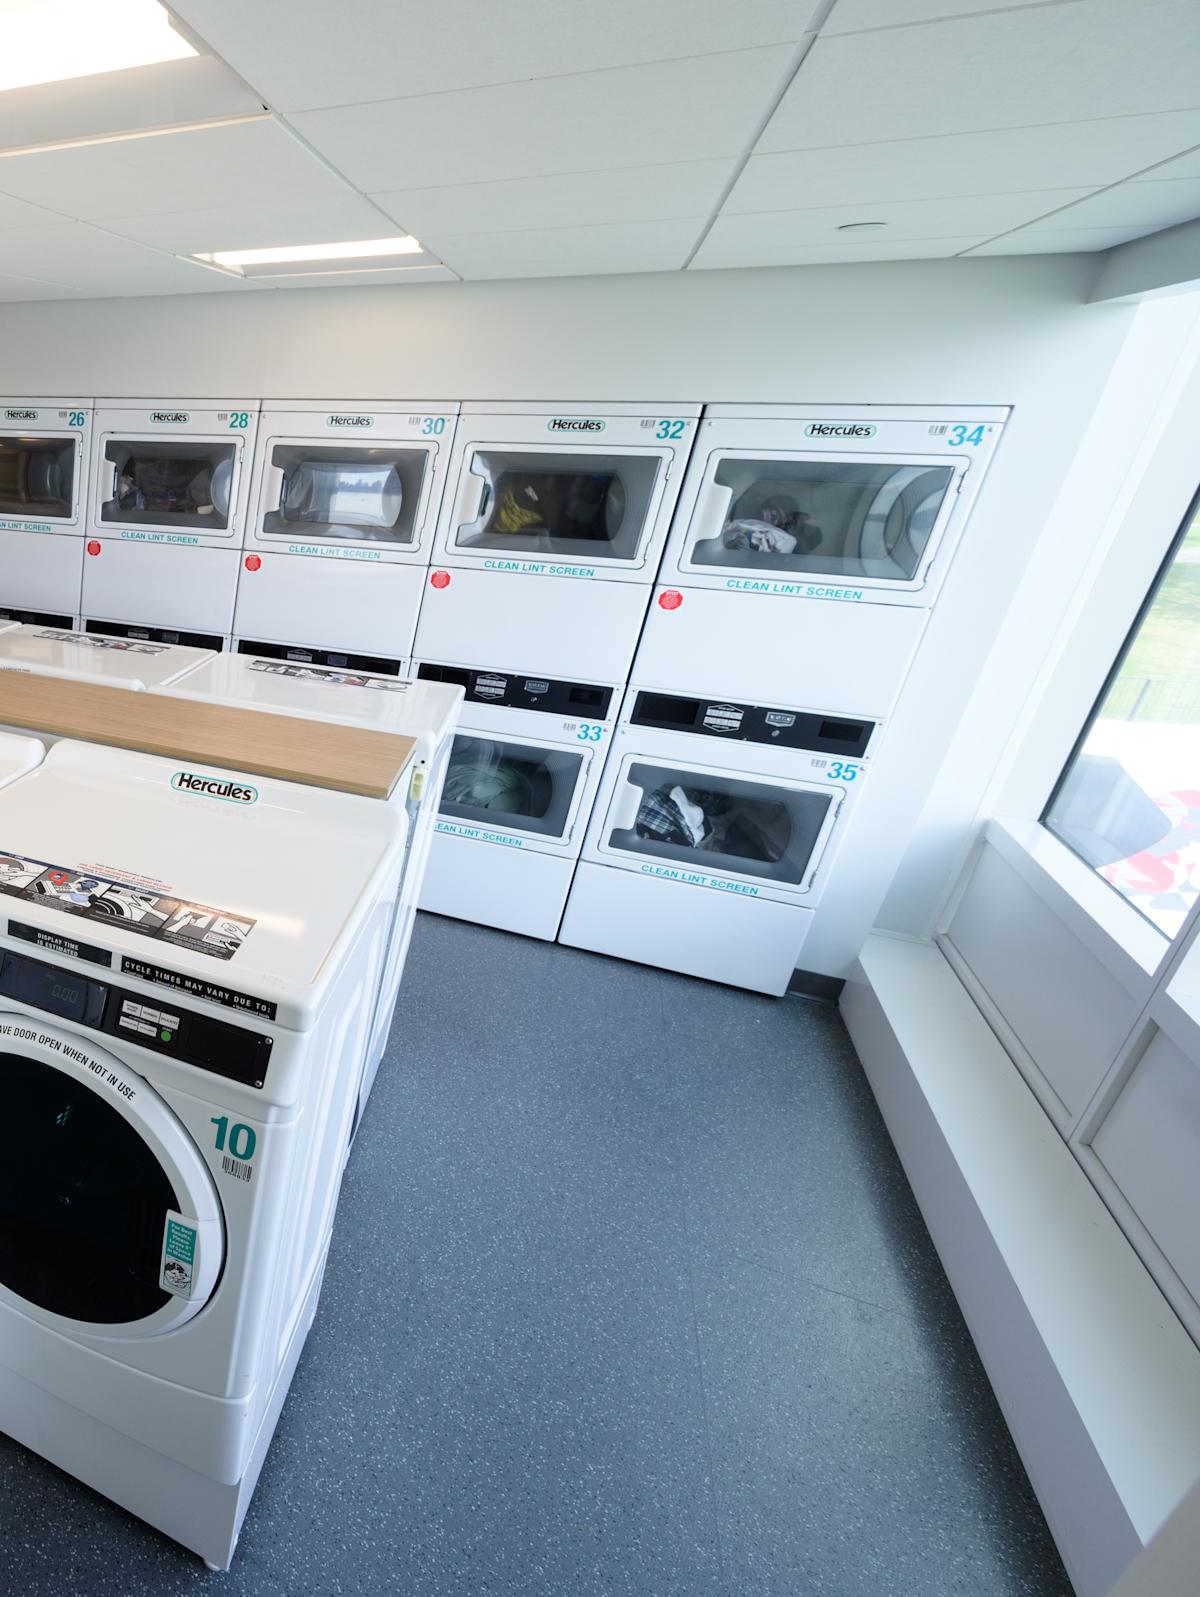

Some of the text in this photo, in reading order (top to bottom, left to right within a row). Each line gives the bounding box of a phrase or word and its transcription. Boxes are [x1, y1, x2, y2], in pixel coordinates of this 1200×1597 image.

[7, 410, 36, 418] Hercules
[68, 412, 85, 426] 26
[153, 412, 188, 422] Hercules
[229, 412, 248, 428] 28
[330, 416, 372, 426] Hercules
[422, 417, 445, 434] 30
[552, 420, 601, 431] Hercules
[656, 420, 685, 440] 32
[810, 424, 871, 436] Hercules
[948, 425, 986, 446] 34
[8, 522, 22, 530] LINT
[24, 524, 50, 532] SCREEN
[121, 532, 198, 544] CLEAN LINT SCREEN
[289, 545, 381, 559] CLEAN LINT SCREEN
[484, 560, 594, 578] CLEAN LINT SCREEN
[726, 580, 862, 600] CLEAN LINT SCREEN
[577, 724, 602, 741] 33
[827, 762, 859, 781] 35
[178, 773, 252, 801] Hercules
[458, 827, 480, 837] LINT
[482, 832, 522, 846] SCREEN
[640, 864, 759, 895] CLEAN LINT SCREEN
[38, 932, 79, 950] DISPLAY TIME
[45, 942, 78, 957] ESTIMATED
[125, 961, 151, 975] CYCLE
[155, 970, 181, 984] TIMES
[184, 980, 203, 991] MAY
[206, 987, 230, 1000] VARY
[234, 996, 251, 1007] DUE
[256, 1003, 271, 1014] TO:
[13, 1027, 37, 1041] DOOR
[38, 1034, 62, 1051] OPEN
[62, 1044, 89, 1066] WHEN
[88, 1060, 108, 1078] NOT
[106, 1073, 118, 1086] IN
[118, 1082, 136, 1101] USE
[210, 1116, 257, 1160] 10
